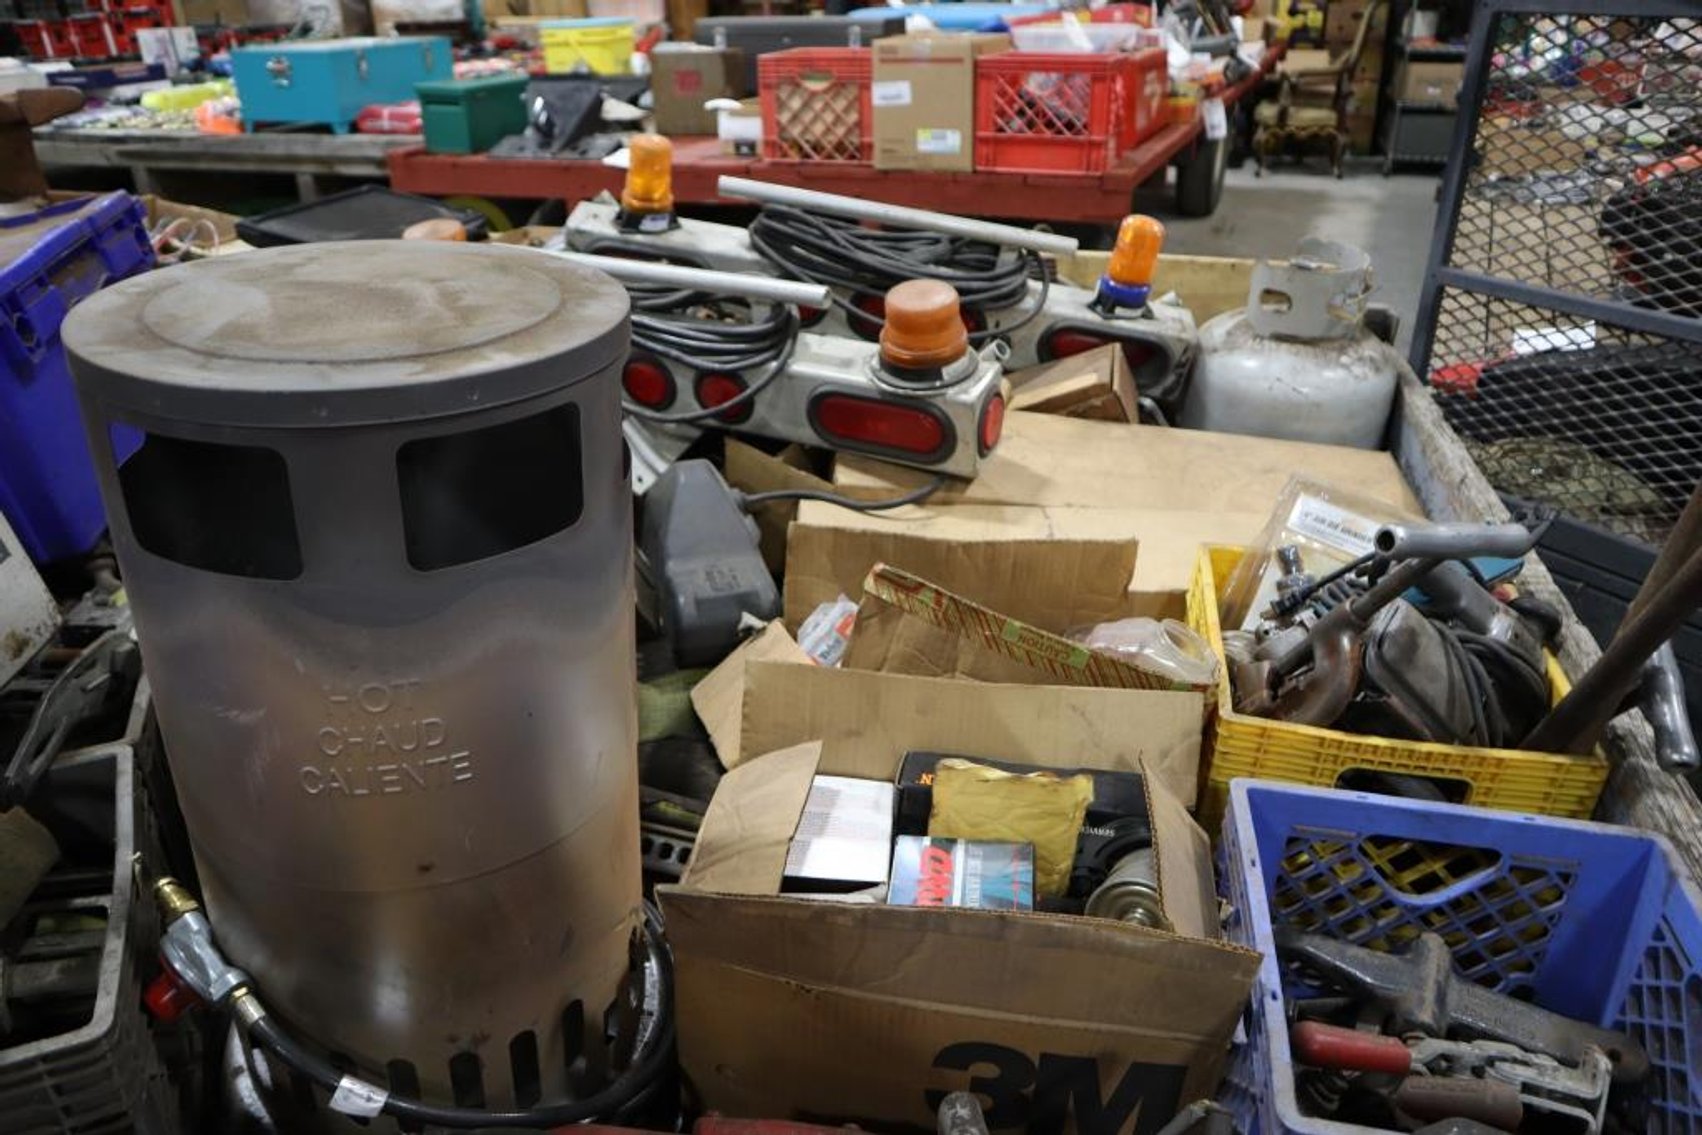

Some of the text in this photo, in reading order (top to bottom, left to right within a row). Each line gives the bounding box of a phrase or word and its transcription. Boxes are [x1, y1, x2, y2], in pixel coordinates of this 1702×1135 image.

[323, 677, 420, 712] HOT
[318, 717, 447, 755] CHAUD
[300, 751, 472, 795] CALIENTE
[924, 1041, 1187, 1135] 3M
